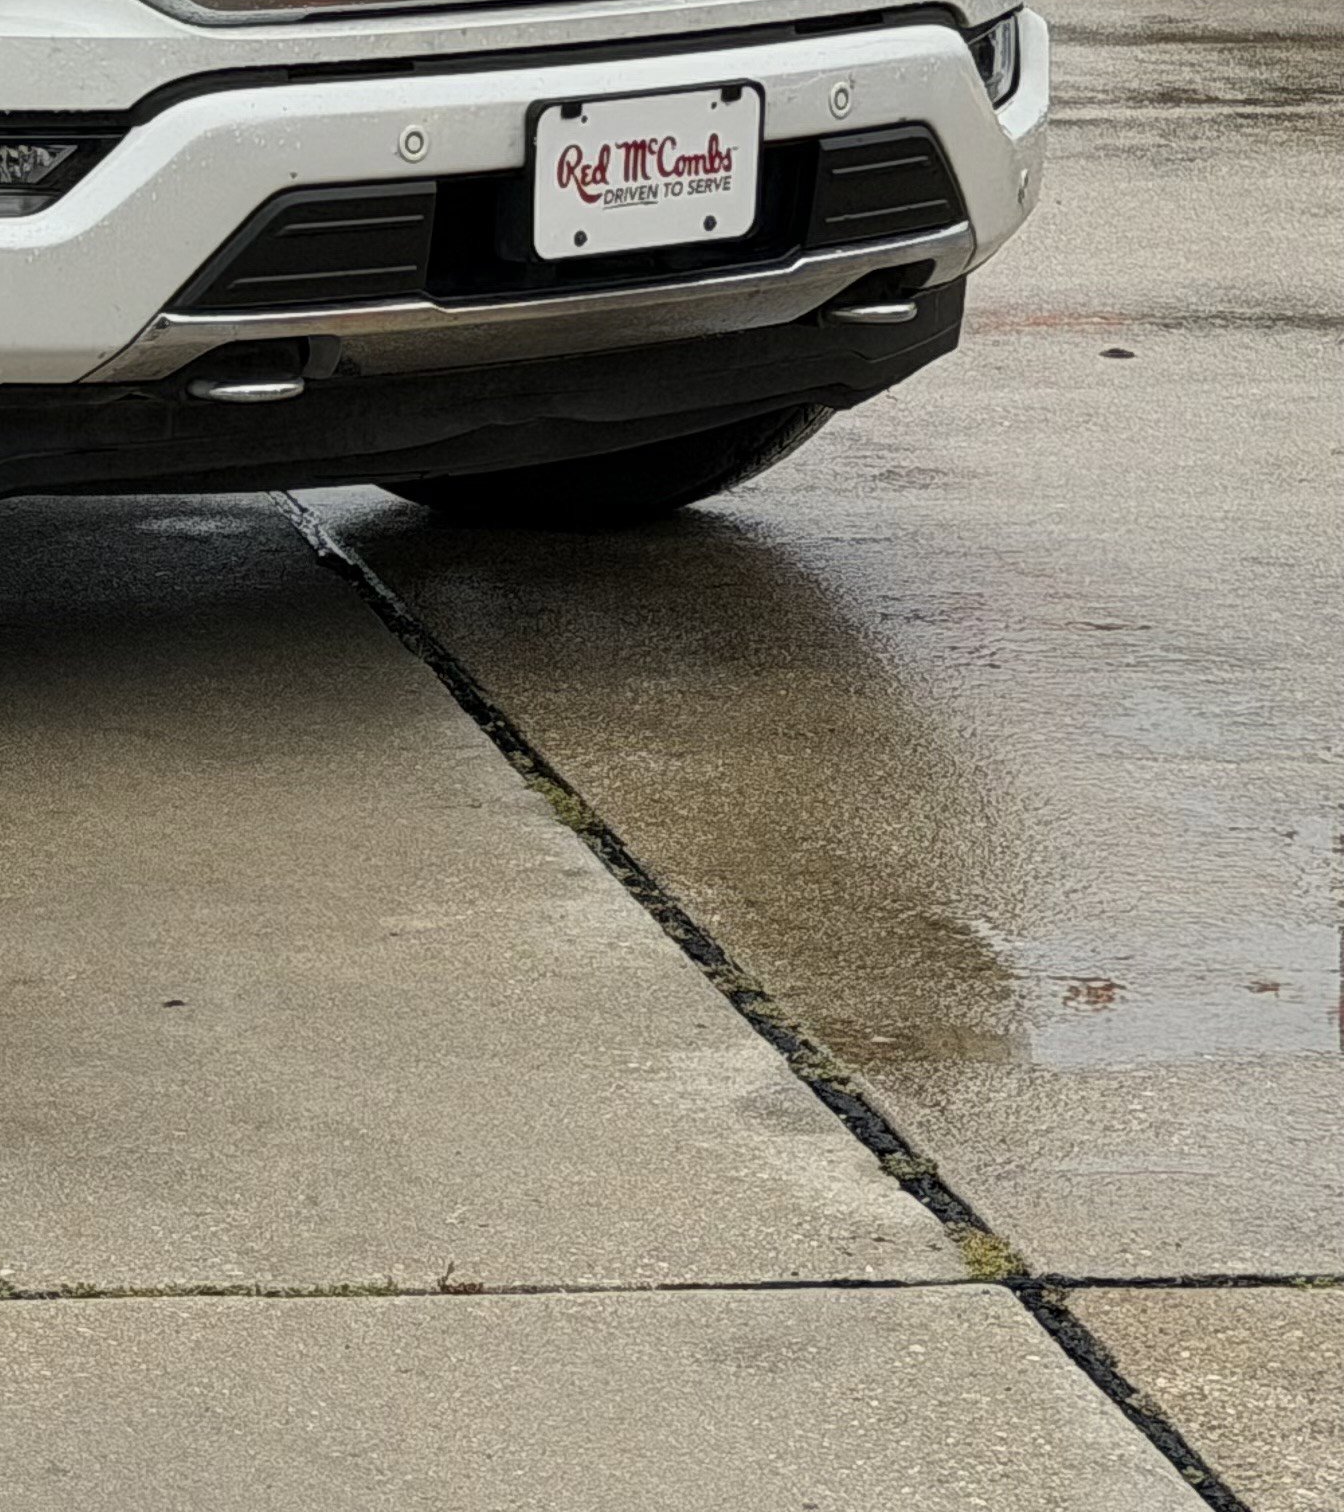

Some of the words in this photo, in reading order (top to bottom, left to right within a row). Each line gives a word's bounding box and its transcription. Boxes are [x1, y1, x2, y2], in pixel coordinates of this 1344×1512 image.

[557, 144, 611, 203] Red
[615, 133, 733, 183] McCombs
[603, 184, 659, 205] DRIVEN
[664, 180, 684, 198] TO
[687, 175, 733, 196] SERVE
